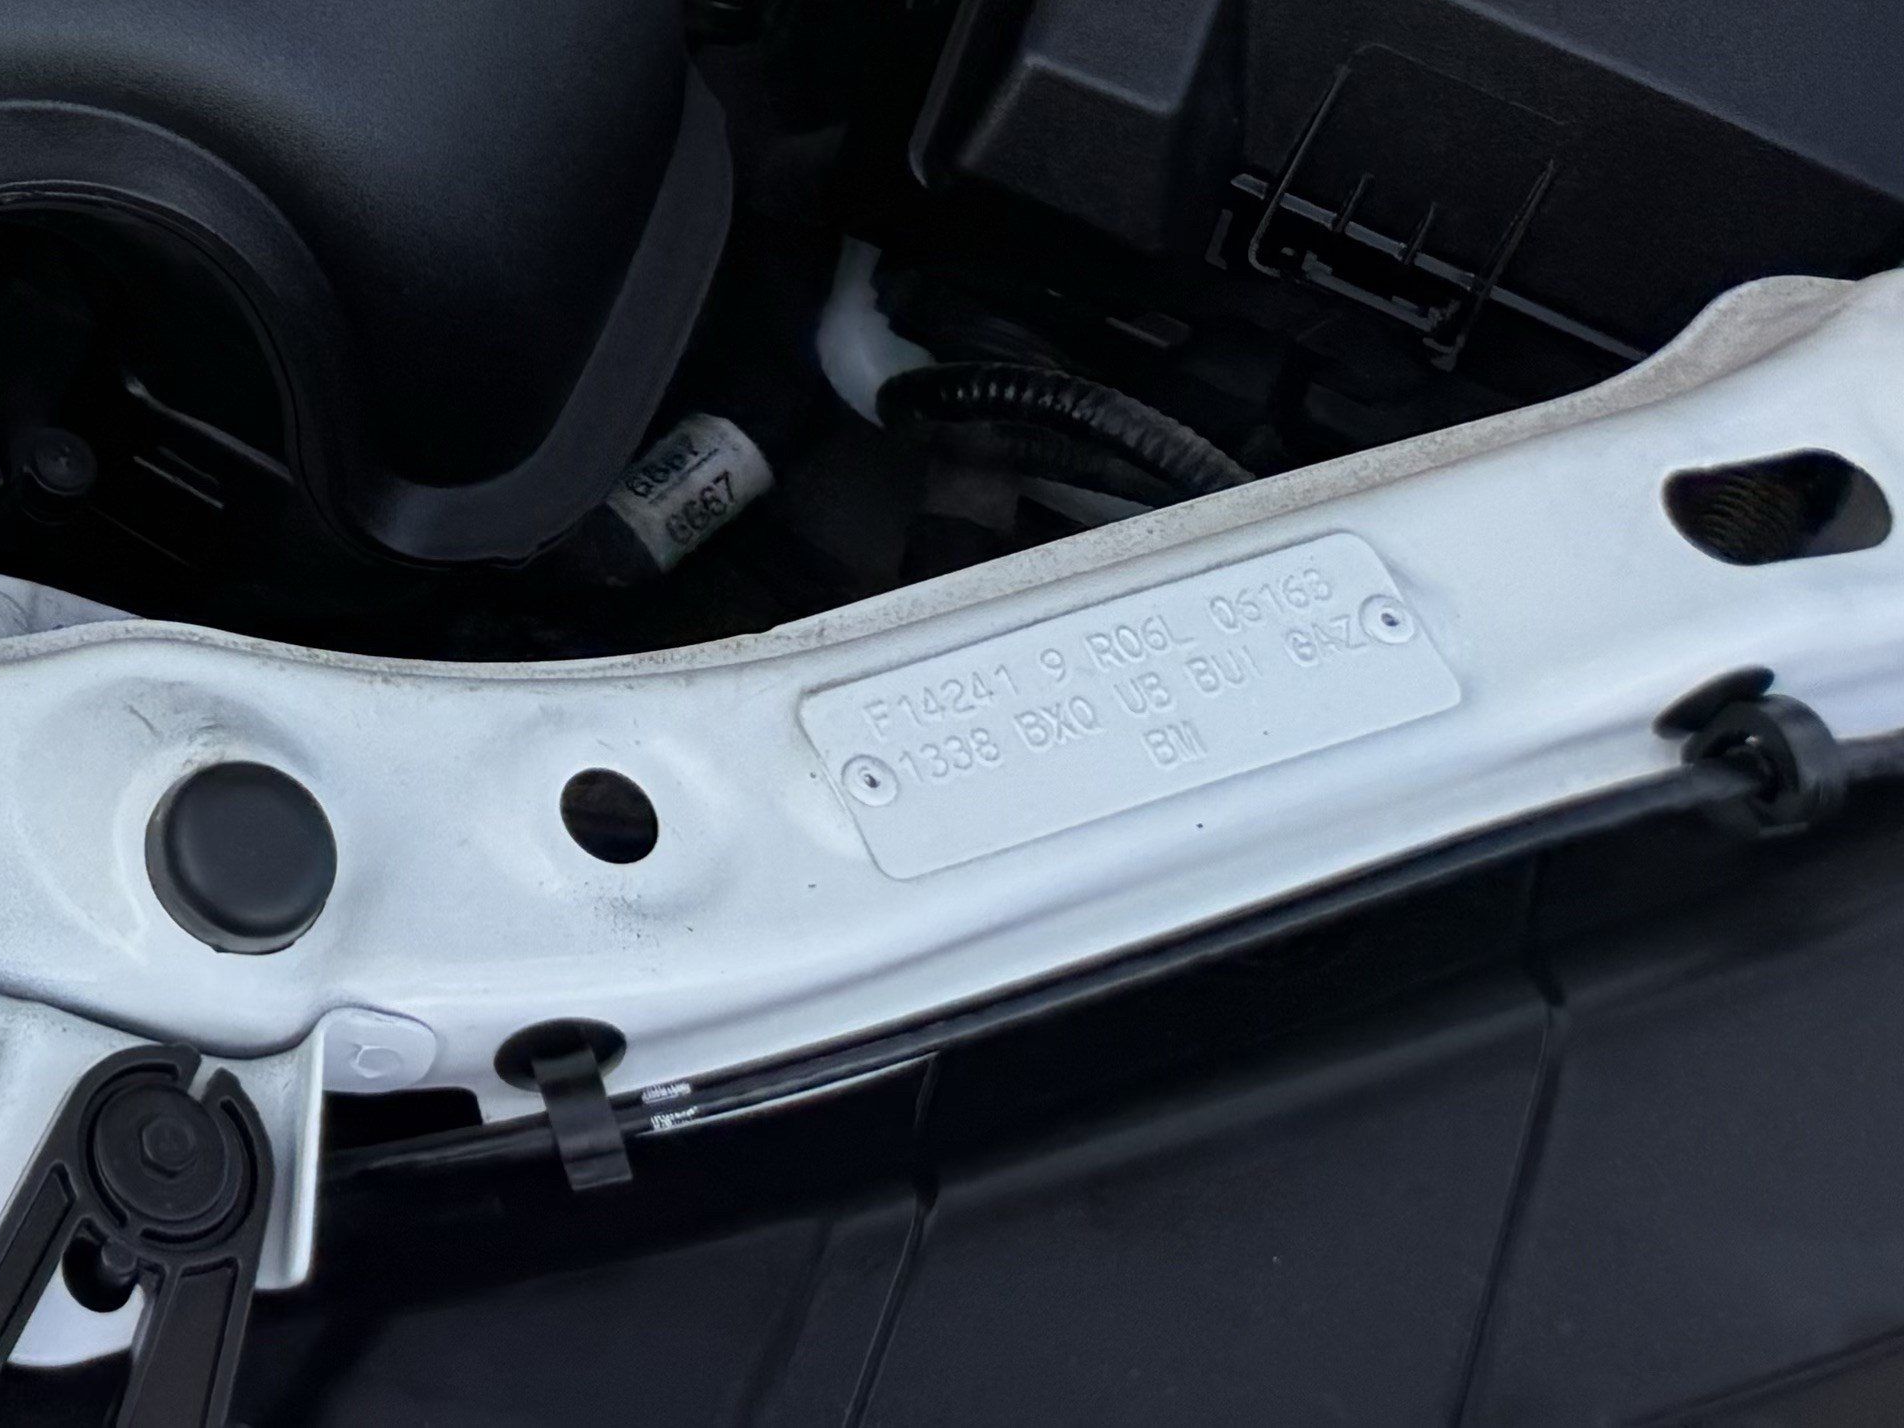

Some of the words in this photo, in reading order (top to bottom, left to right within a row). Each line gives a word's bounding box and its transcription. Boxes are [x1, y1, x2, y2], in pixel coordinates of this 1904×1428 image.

[1038, 647, 1069, 685] 9
[900, 727, 1002, 785] 1338
[1113, 670, 1177, 717] UB
